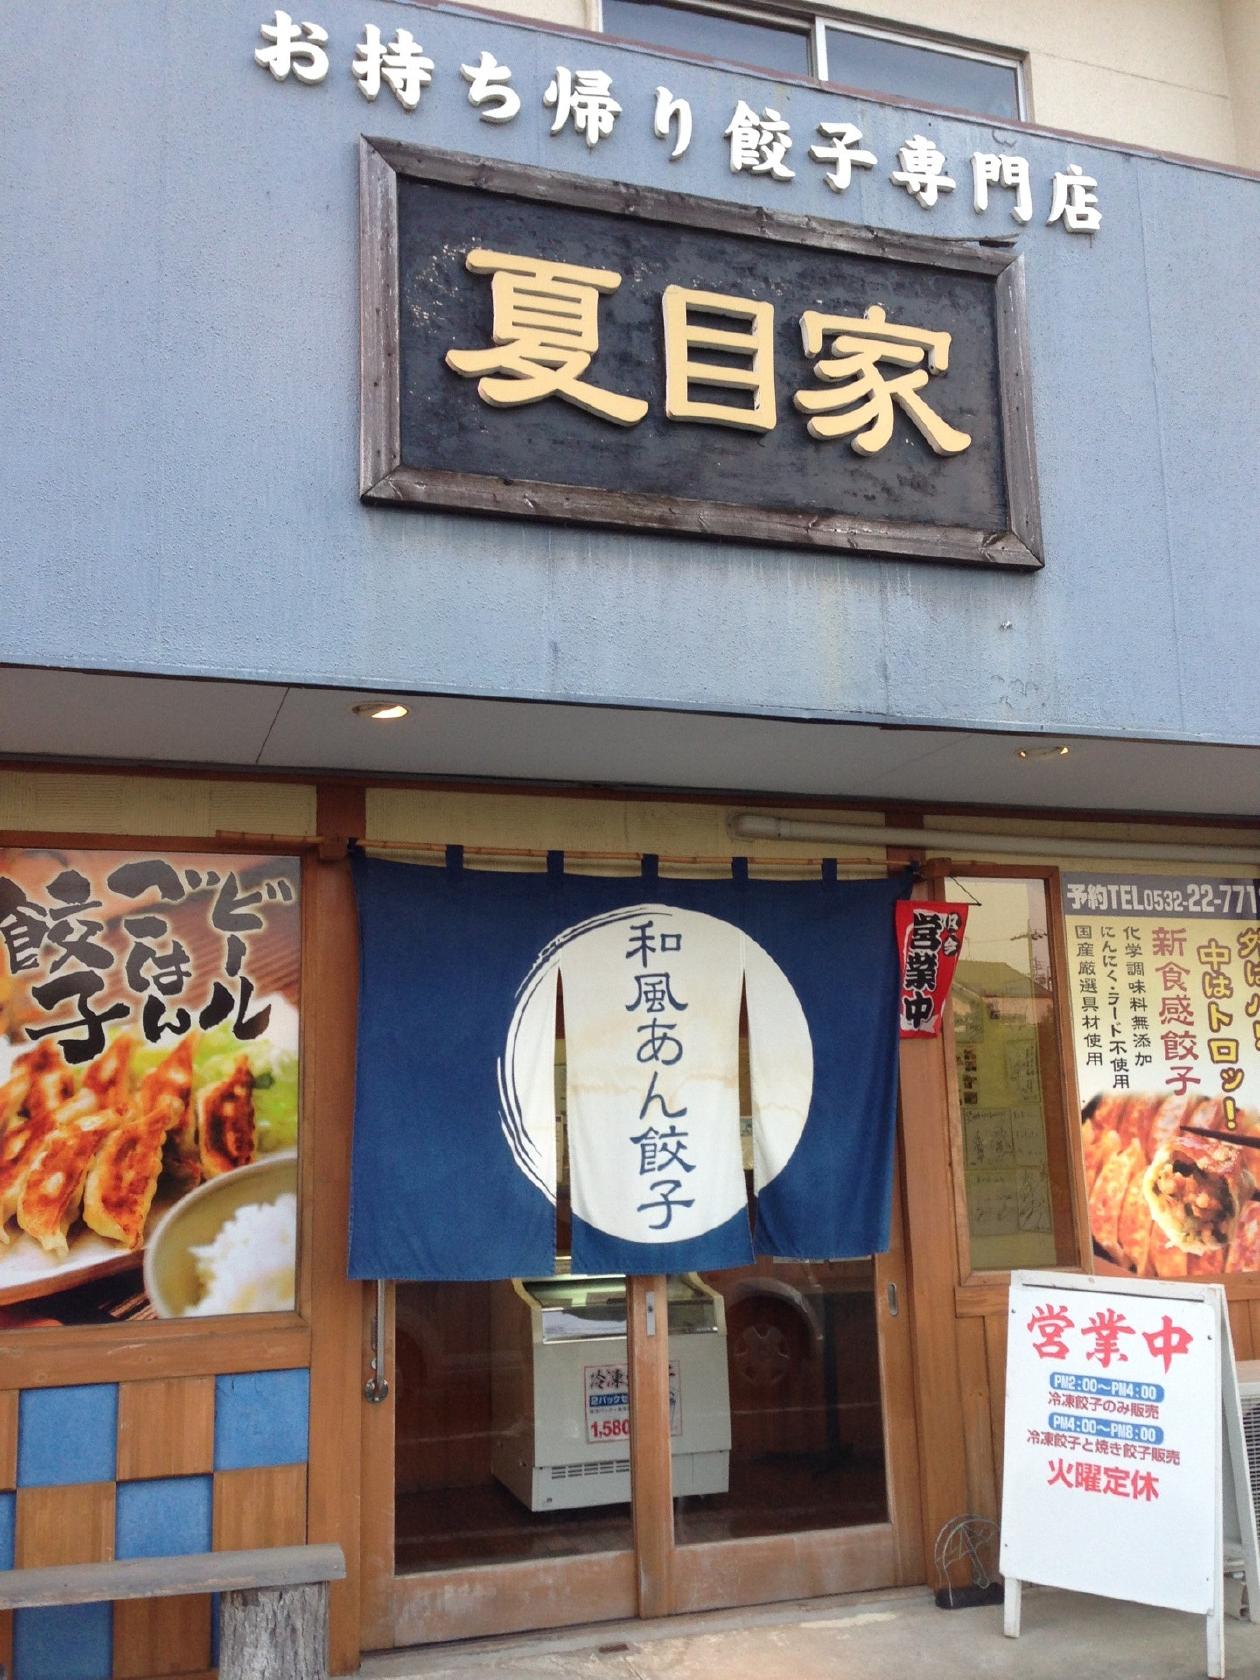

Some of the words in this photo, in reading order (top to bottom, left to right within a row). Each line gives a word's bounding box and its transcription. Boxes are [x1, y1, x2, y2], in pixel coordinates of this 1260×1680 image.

[254, 8, 1103, 234] お持ち帰り餃子専門店
[446, 248, 971, 458] 夏目家
[0, 869, 131, 1065] 餃子
[107, 859, 220, 1044] ごはん
[199, 871, 293, 1041] ビール
[903, 911, 942, 1030] 営業中
[1066, 882, 1260, 914] 予約TEL0532-22-771
[1075, 925, 1103, 1067] 国産厳選具材使用
[1101, 926, 1130, 1089] にんにく・ラード不使用
[1123, 925, 1152, 1067] 化学調味料無添加
[1151, 926, 1201, 1096] 新食感餃子
[625, 920, 696, 1229] 和風あん餃子
[1027, 1304, 1194, 1375] 営業中
[1047, 1391, 1160, 1420] 冷凍餃子のみ販売
[1026, 1429, 1181, 1466] 冷凍餃子と焼き餃子販売
[1046, 1458, 1160, 1502] 火曜定休
